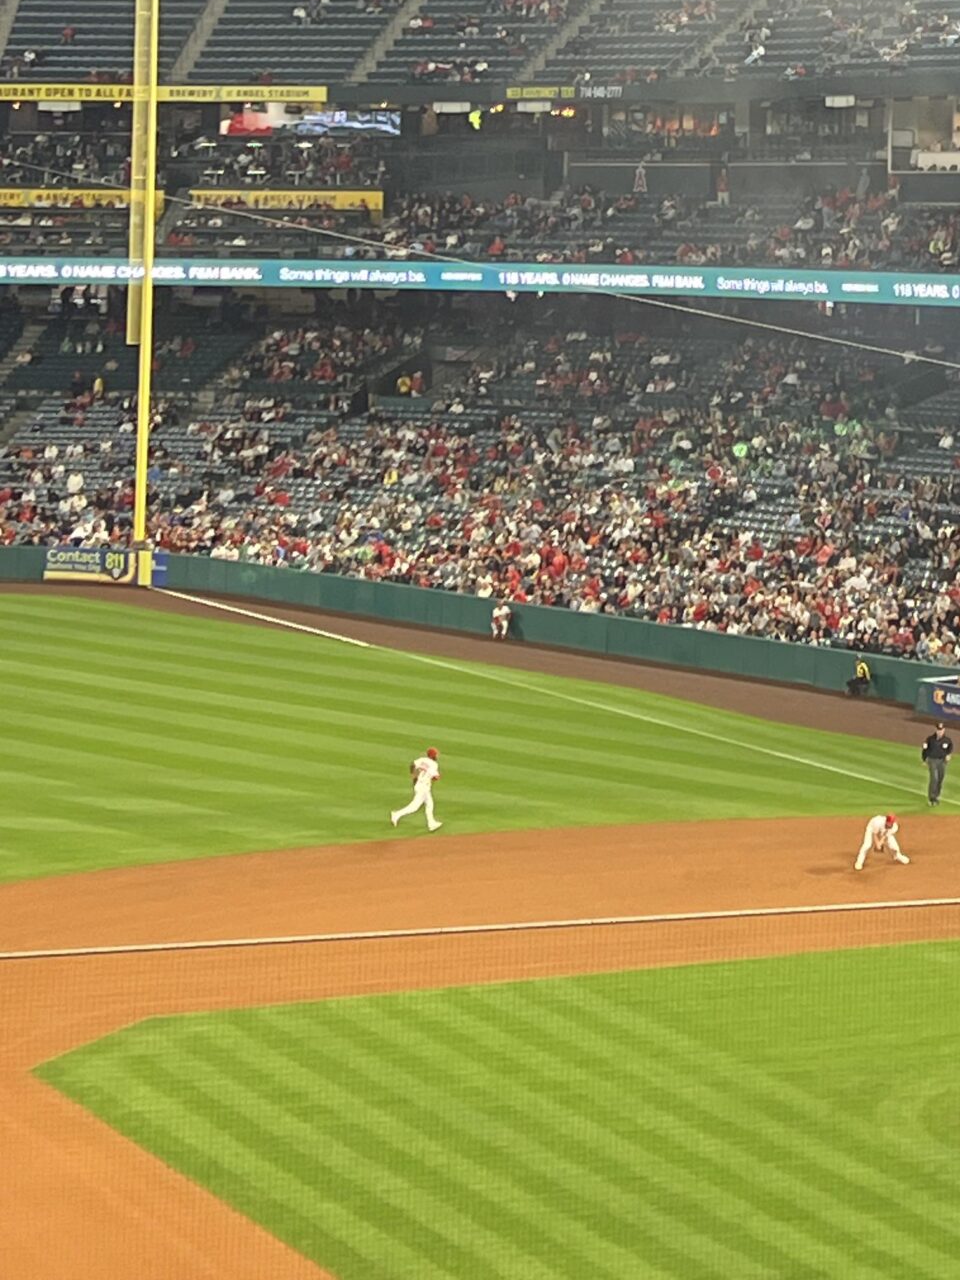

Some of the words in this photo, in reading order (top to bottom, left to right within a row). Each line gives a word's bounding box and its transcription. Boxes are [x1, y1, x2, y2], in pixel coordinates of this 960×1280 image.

[45, 87, 75, 97] OPEN
[78, 88, 92, 97] TO
[95, 88, 115, 97] ALL
[236, 88, 265, 98] ANGEL
[268, 88, 310, 97] STADIUM
[73, 266, 115, 278] NAME
[116, 266, 186, 279] CHAGES.
[279, 267, 314, 281] Some
[315, 269, 349, 283] things
[350, 270, 368, 281] will
[369, 270, 407, 285] always
[570, 274, 599, 287] NAME
[717, 276, 743, 290] Some
[743, 278, 770, 294] things
[770, 280, 784, 292] will
[785, 280, 814, 295] always
[46, 549, 101, 564] Contact
[105, 552, 124, 570] 811
